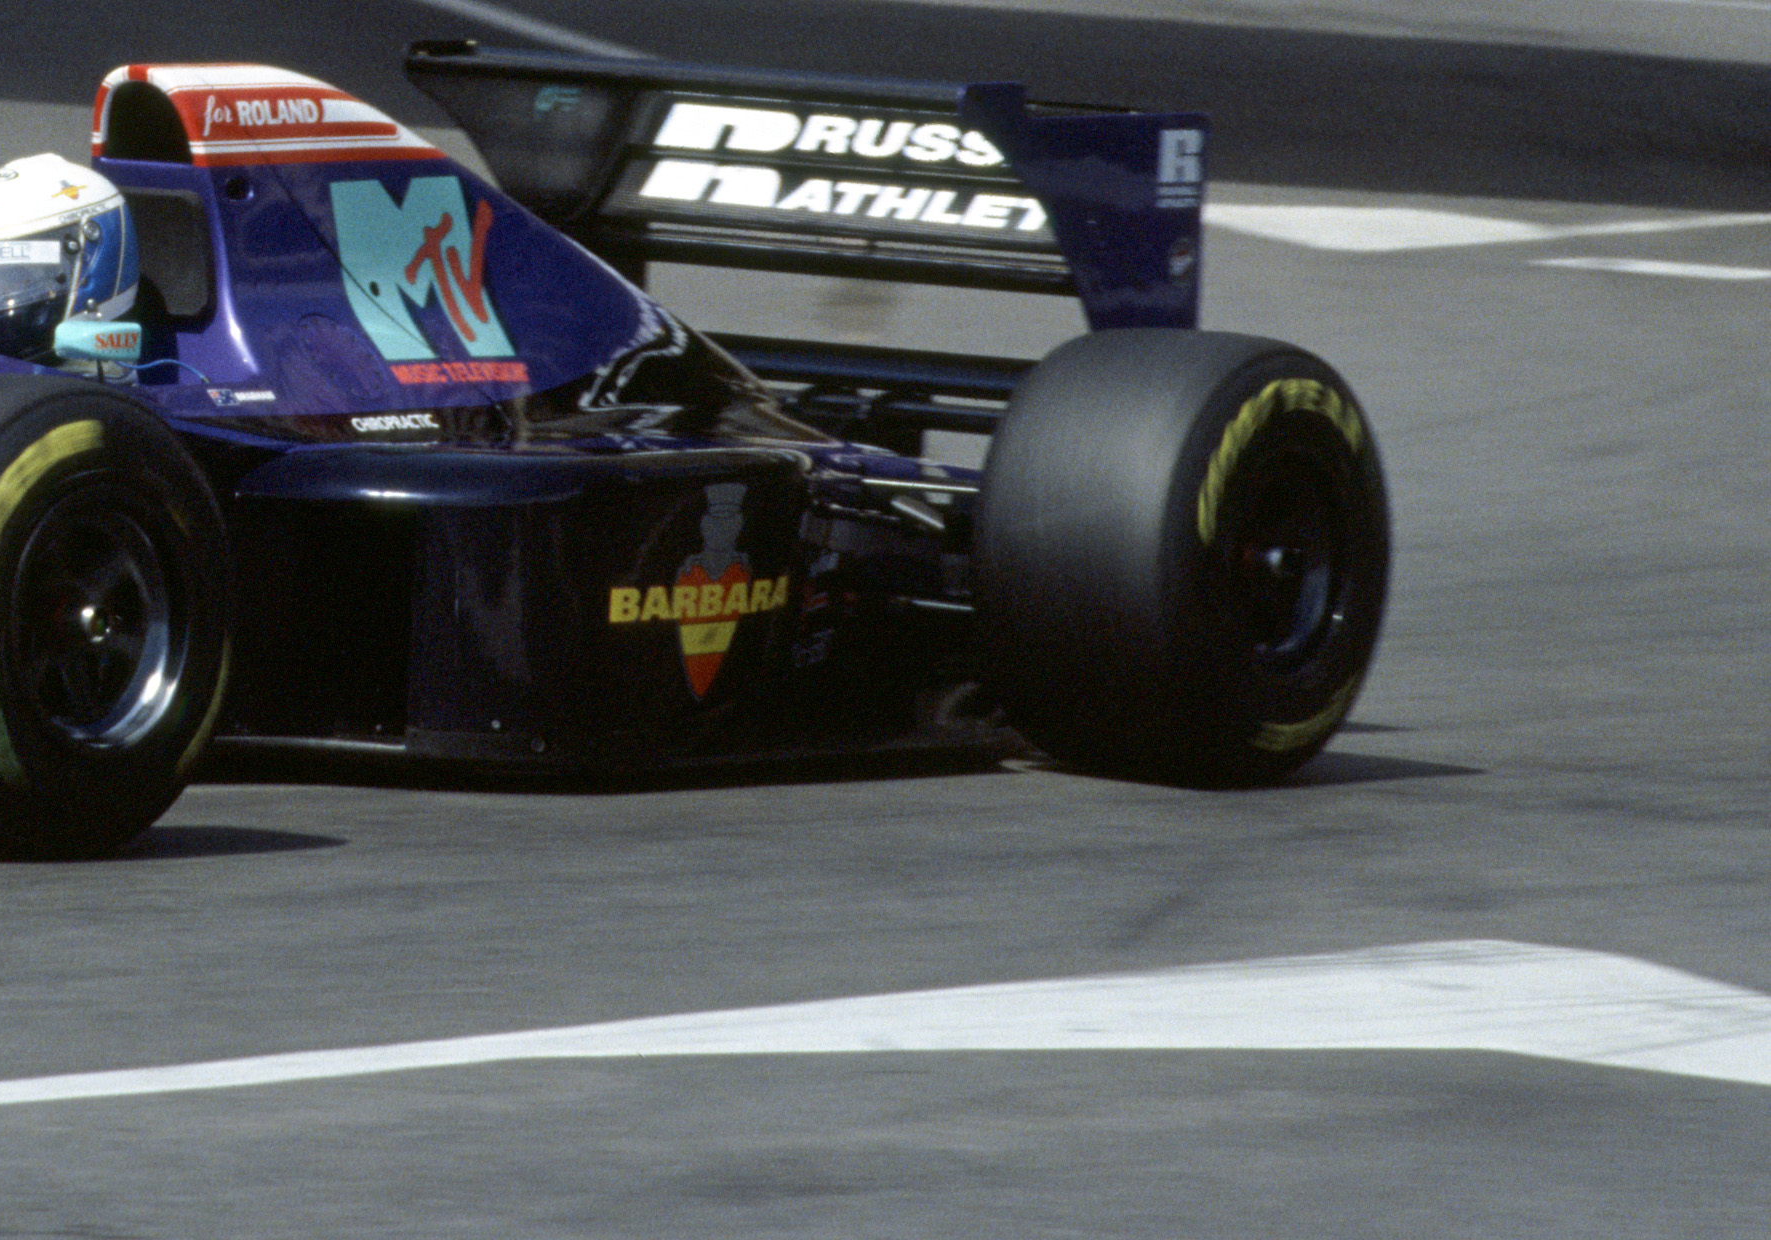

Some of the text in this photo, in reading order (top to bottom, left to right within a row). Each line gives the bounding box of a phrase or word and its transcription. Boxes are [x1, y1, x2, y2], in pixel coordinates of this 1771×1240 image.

[203, 94, 320, 137] for ROLAND
[329, 176, 518, 360] MTV
[94, 332, 140, 350] SALLY
[350, 412, 440, 433] CHIROPRACTIC
[609, 575, 789, 624] BARBARA
